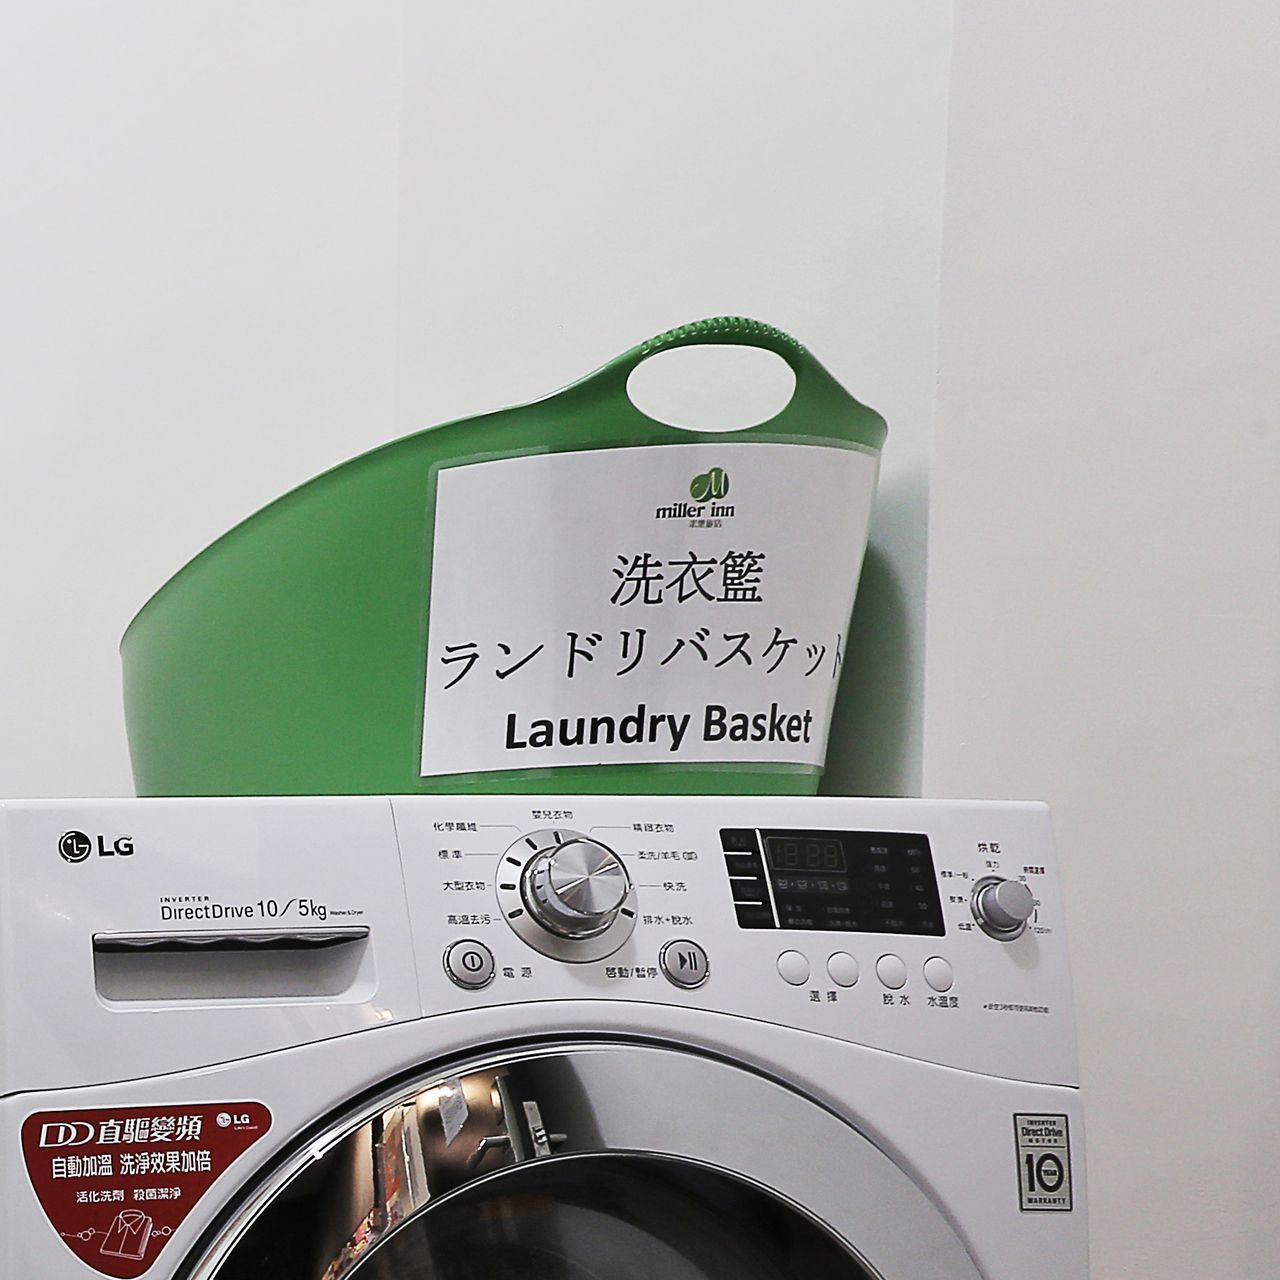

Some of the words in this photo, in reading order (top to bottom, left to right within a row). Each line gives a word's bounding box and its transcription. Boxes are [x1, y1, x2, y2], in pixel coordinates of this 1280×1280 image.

[655, 503, 706, 519] miller
[710, 502, 735, 518] inn
[609, 550, 766, 607] 洗衣籃
[440, 626, 842, 690] ランドリバスケット
[505, 703, 690, 751] Laundry
[704, 703, 813, 744] Basket
[97, 835, 134, 857] LG
[160, 895, 210, 903] INVERTER
[233, 1113, 250, 1125] LG
[1021, 1127, 1043, 1137] Direct
[1044, 1127, 1063, 1137] Drive
[52, 1155, 113, 1179] 自動加溫
[120, 1150, 212, 1175] 洗淨效果加倍
[1025, 1153, 1064, 1193] 10
